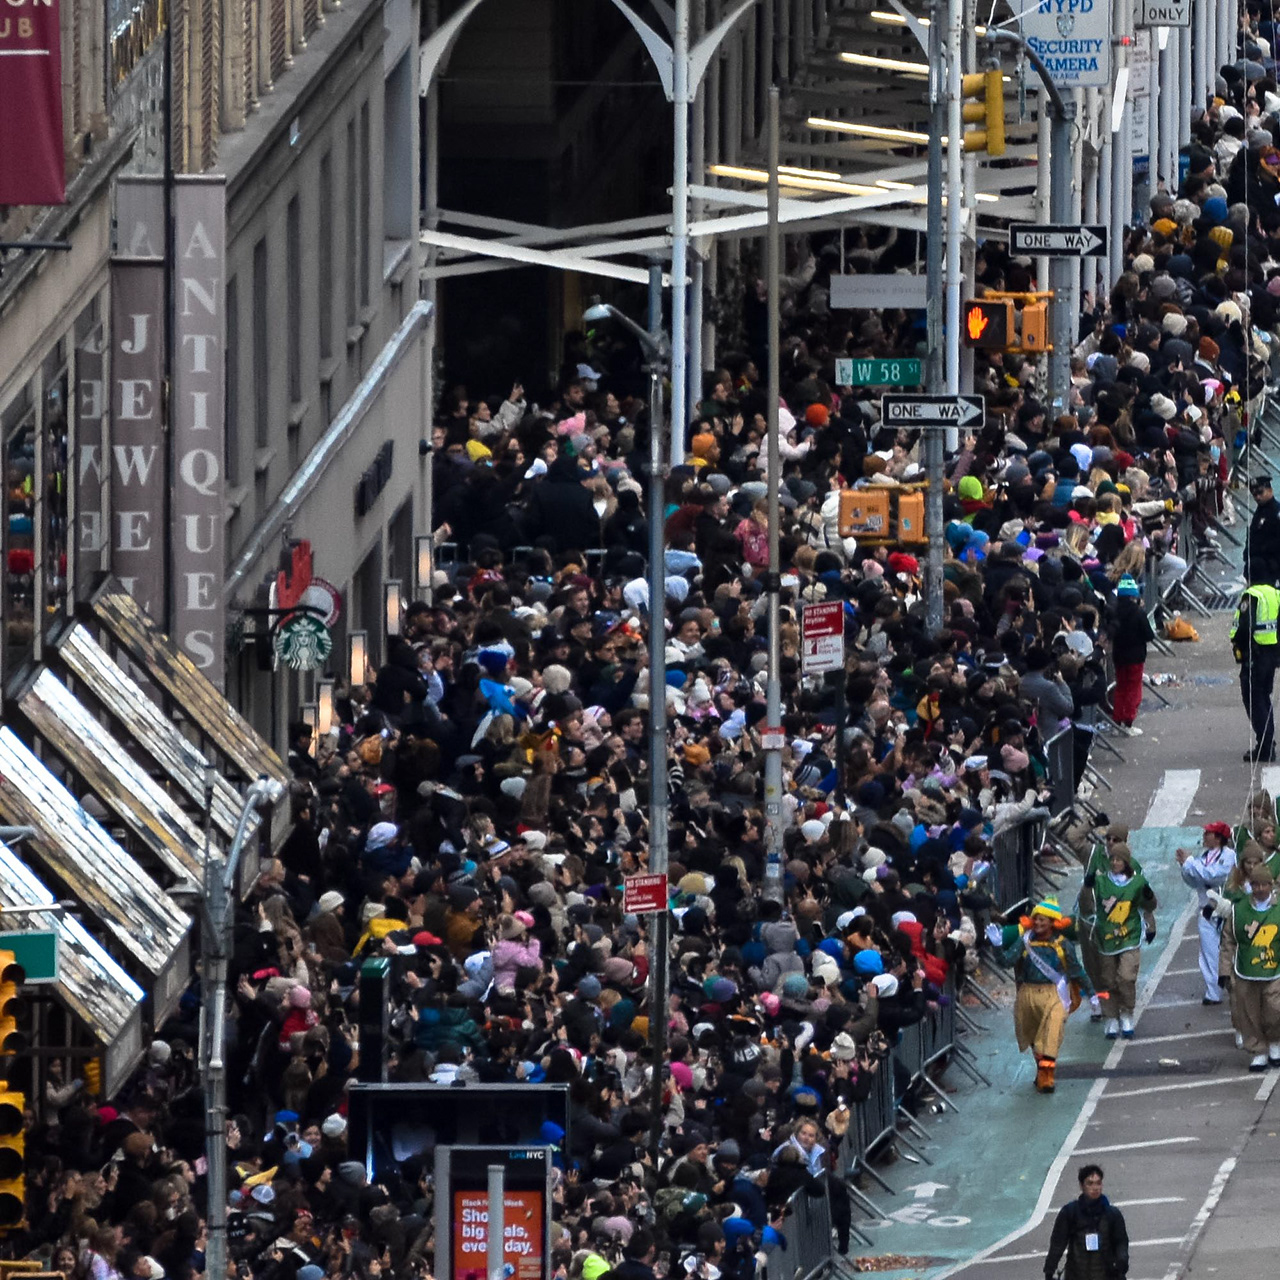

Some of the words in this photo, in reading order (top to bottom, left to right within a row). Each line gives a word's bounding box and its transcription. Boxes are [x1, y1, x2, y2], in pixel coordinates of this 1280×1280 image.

[1149, 8, 1184, 20] ONLY
[1027, 36, 1102, 53] SECURITY
[1024, 233, 1051, 247] ONE
[1064, 234, 1092, 248] WAY
[857, 363, 872, 381] W
[880, 363, 900, 381] 58
[892, 405, 922, 417] ONE
[938, 405, 970, 417] WAY
[179, 221, 219, 669] ANTIQUES
[462, 1225, 484, 1239] big
[504, 1240, 533, 1255] day.
